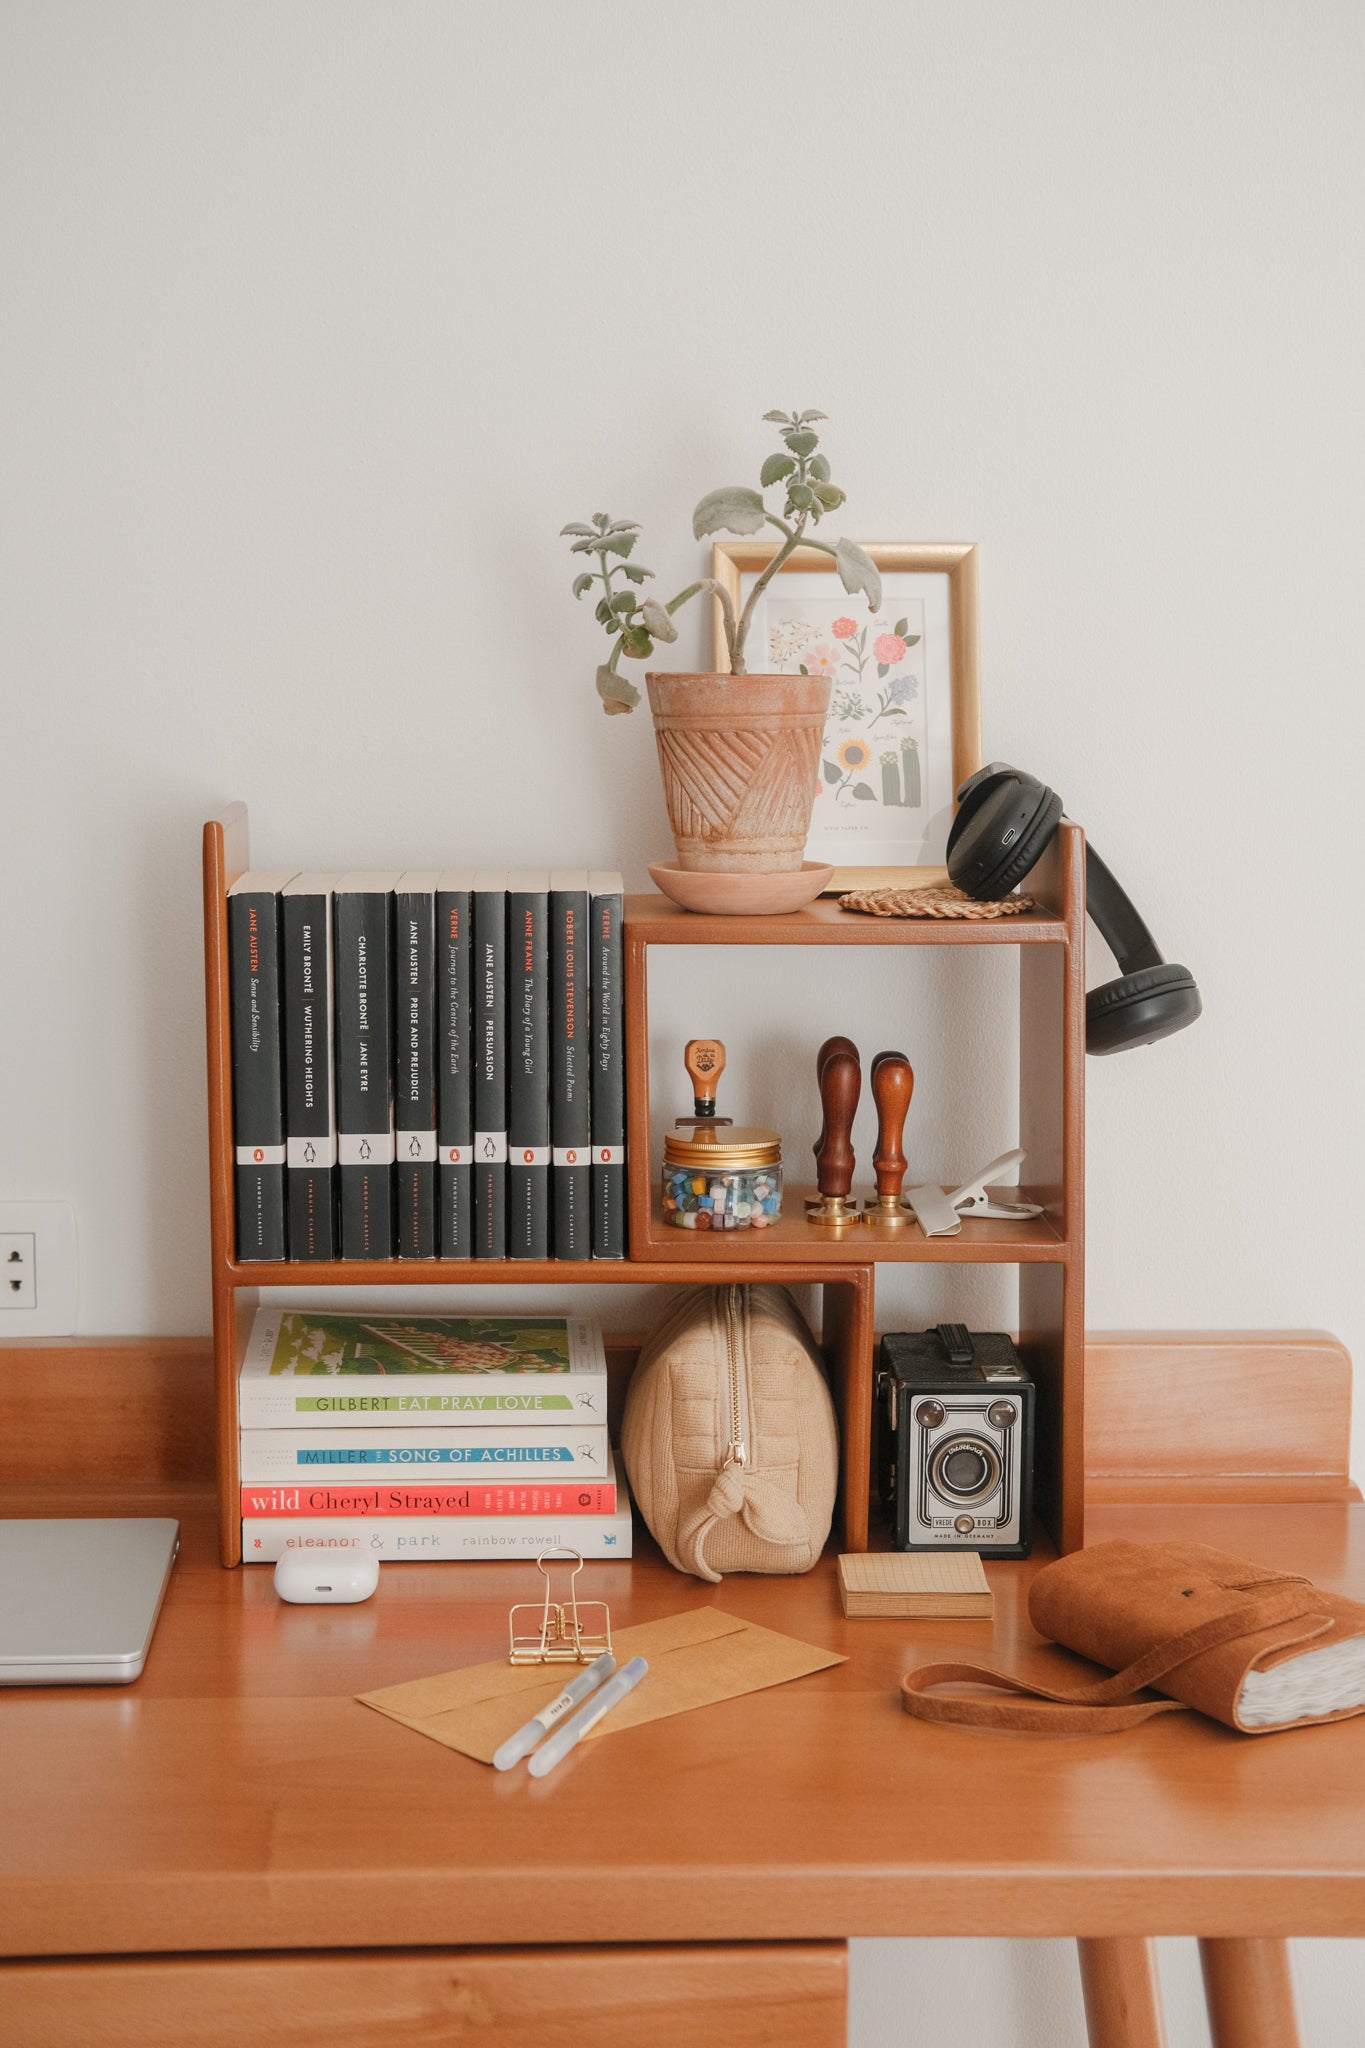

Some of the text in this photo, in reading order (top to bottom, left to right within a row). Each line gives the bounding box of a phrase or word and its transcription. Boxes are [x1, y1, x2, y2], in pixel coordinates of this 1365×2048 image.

[250, 935, 258, 972] AUSTEN
[358, 936, 367, 990] CHARLOTTE
[448, 945, 459, 975] Journey
[304, 956, 313, 993] BRONTË
[525, 978, 533, 992] The
[251, 978, 259, 997] Sense
[251, 999, 259, 1012] and
[359, 992, 369, 1030] BRONTË
[451, 1001, 459, 1026] Centre
[522, 994, 533, 1015] Diary
[250, 1014, 260, 1052] Sensibility
[522, 1017, 533, 1027] of
[304, 1006, 313, 1064] WUTHERING
[448, 1029, 459, 1039] of
[522, 1034, 533, 1056] Young
[600, 1027, 610, 1050] Eighty
[525, 1058, 533, 1074] Girl
[567, 1046, 575, 1076] Selected
[600, 1053, 610, 1071] Days
[316, 1396, 542, 1411] GILBERT EAT PRAY LOVE
[306, 1450, 368, 1463] MILLER
[389, 1450, 441, 1462] SONG
[450, 1450, 472, 1462] OF
[481, 1448, 561, 1461] ACHILLES
[252, 1490, 470, 1514] wild Cheryl Strayed
[286, 1534, 561, 1550] eleanor & park rainbow rowell
